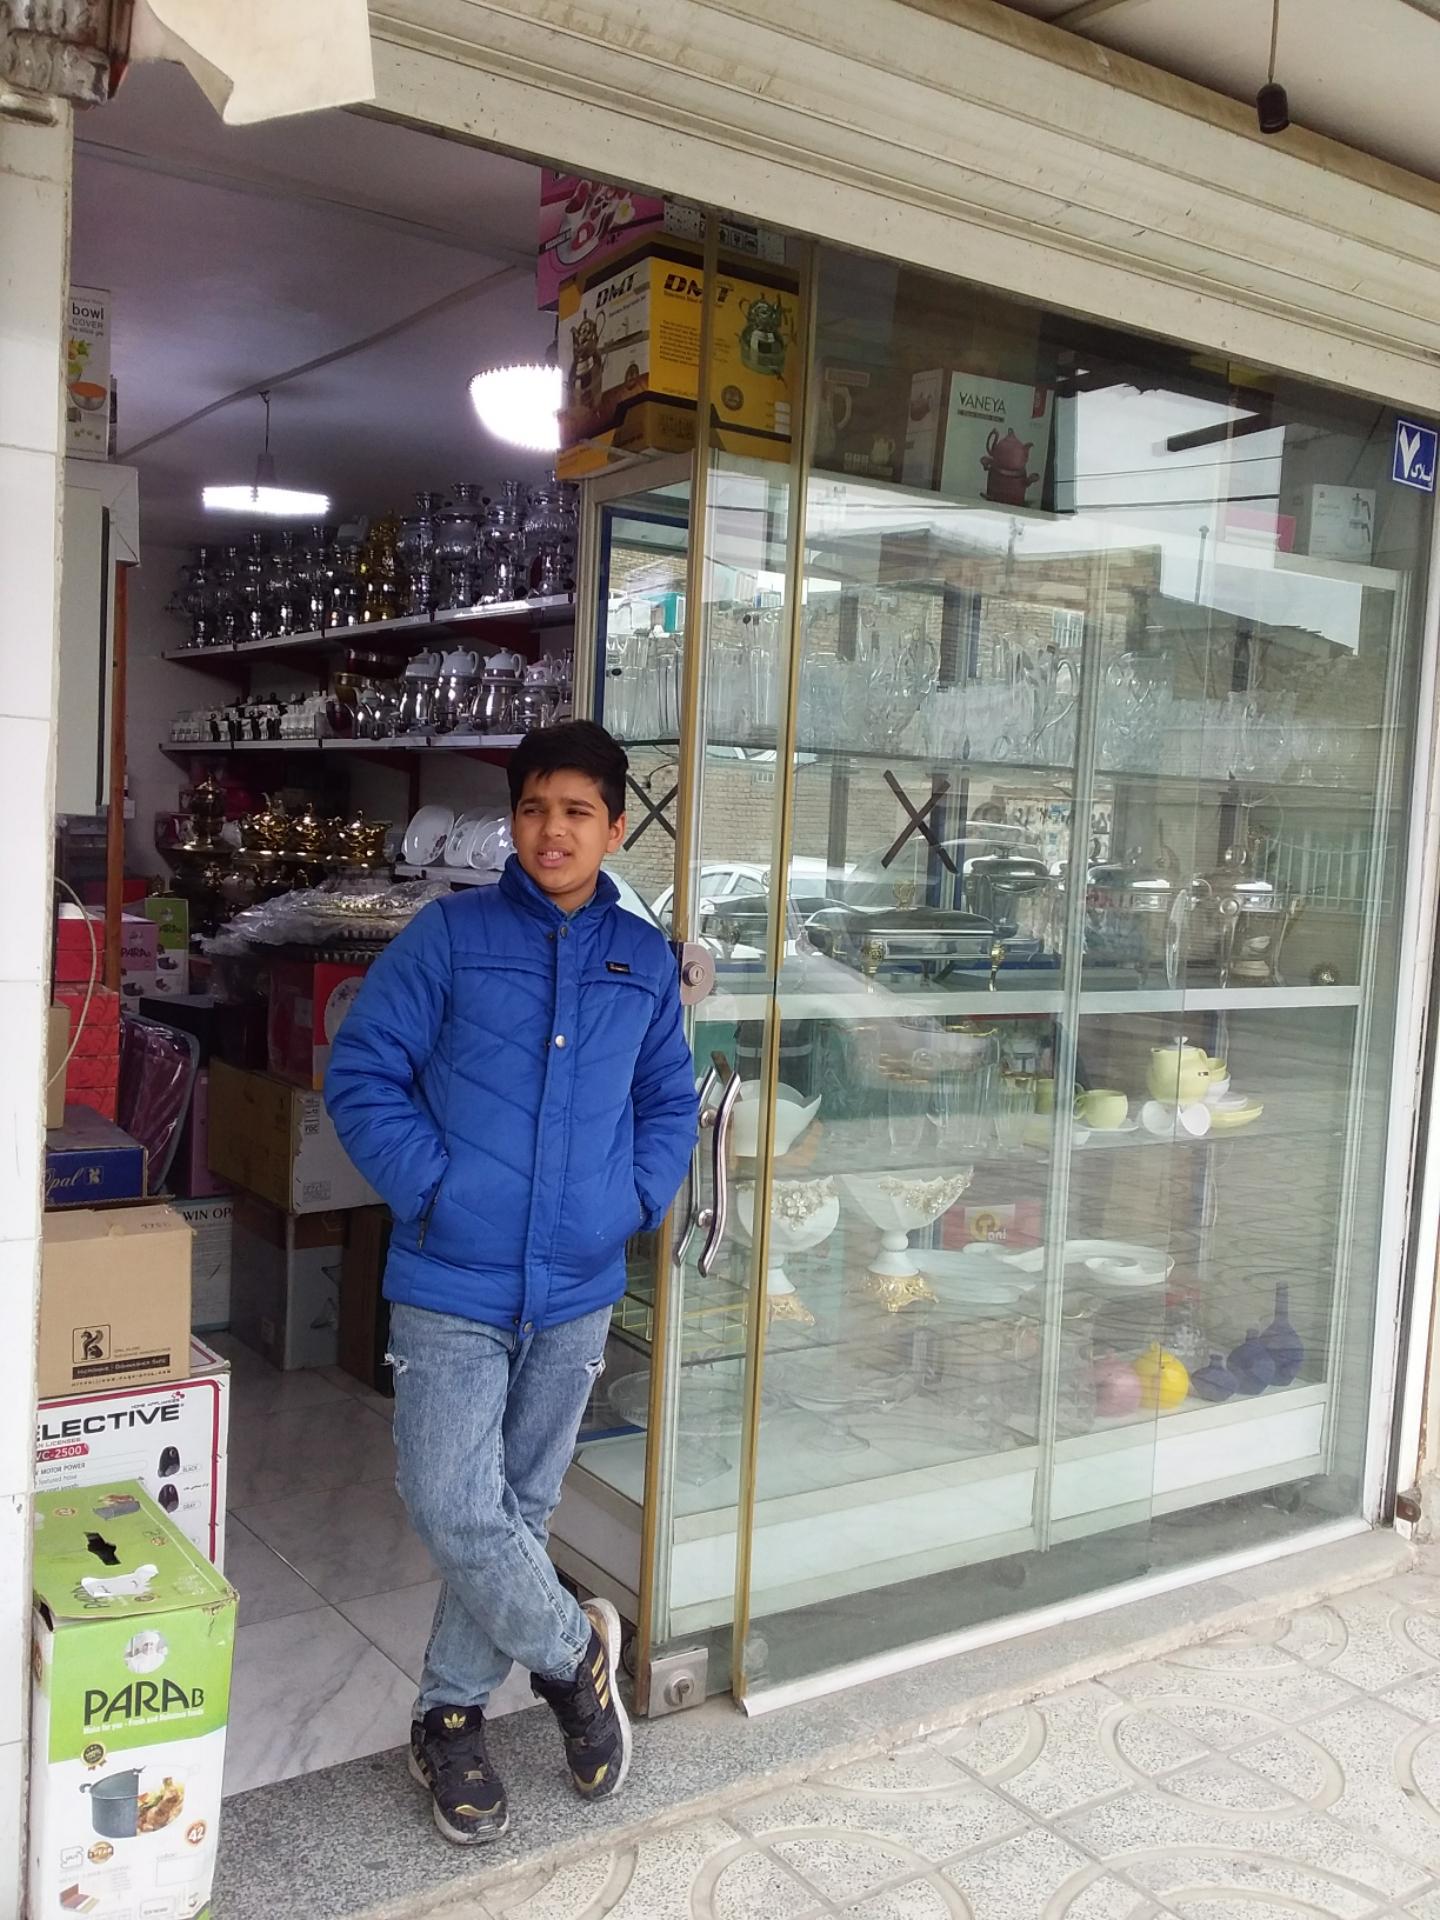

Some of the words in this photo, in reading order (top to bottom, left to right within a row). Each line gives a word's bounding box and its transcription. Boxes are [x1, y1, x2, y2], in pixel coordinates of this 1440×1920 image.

[595, 272, 637, 308] DMT
[72, 302, 104, 320] bowl
[213, 1207, 233, 1219] OP
[40, 1465, 62, 1475] MOTOR
[63, 1462, 86, 1472] POWER
[188, 1826, 205, 1843] 42
